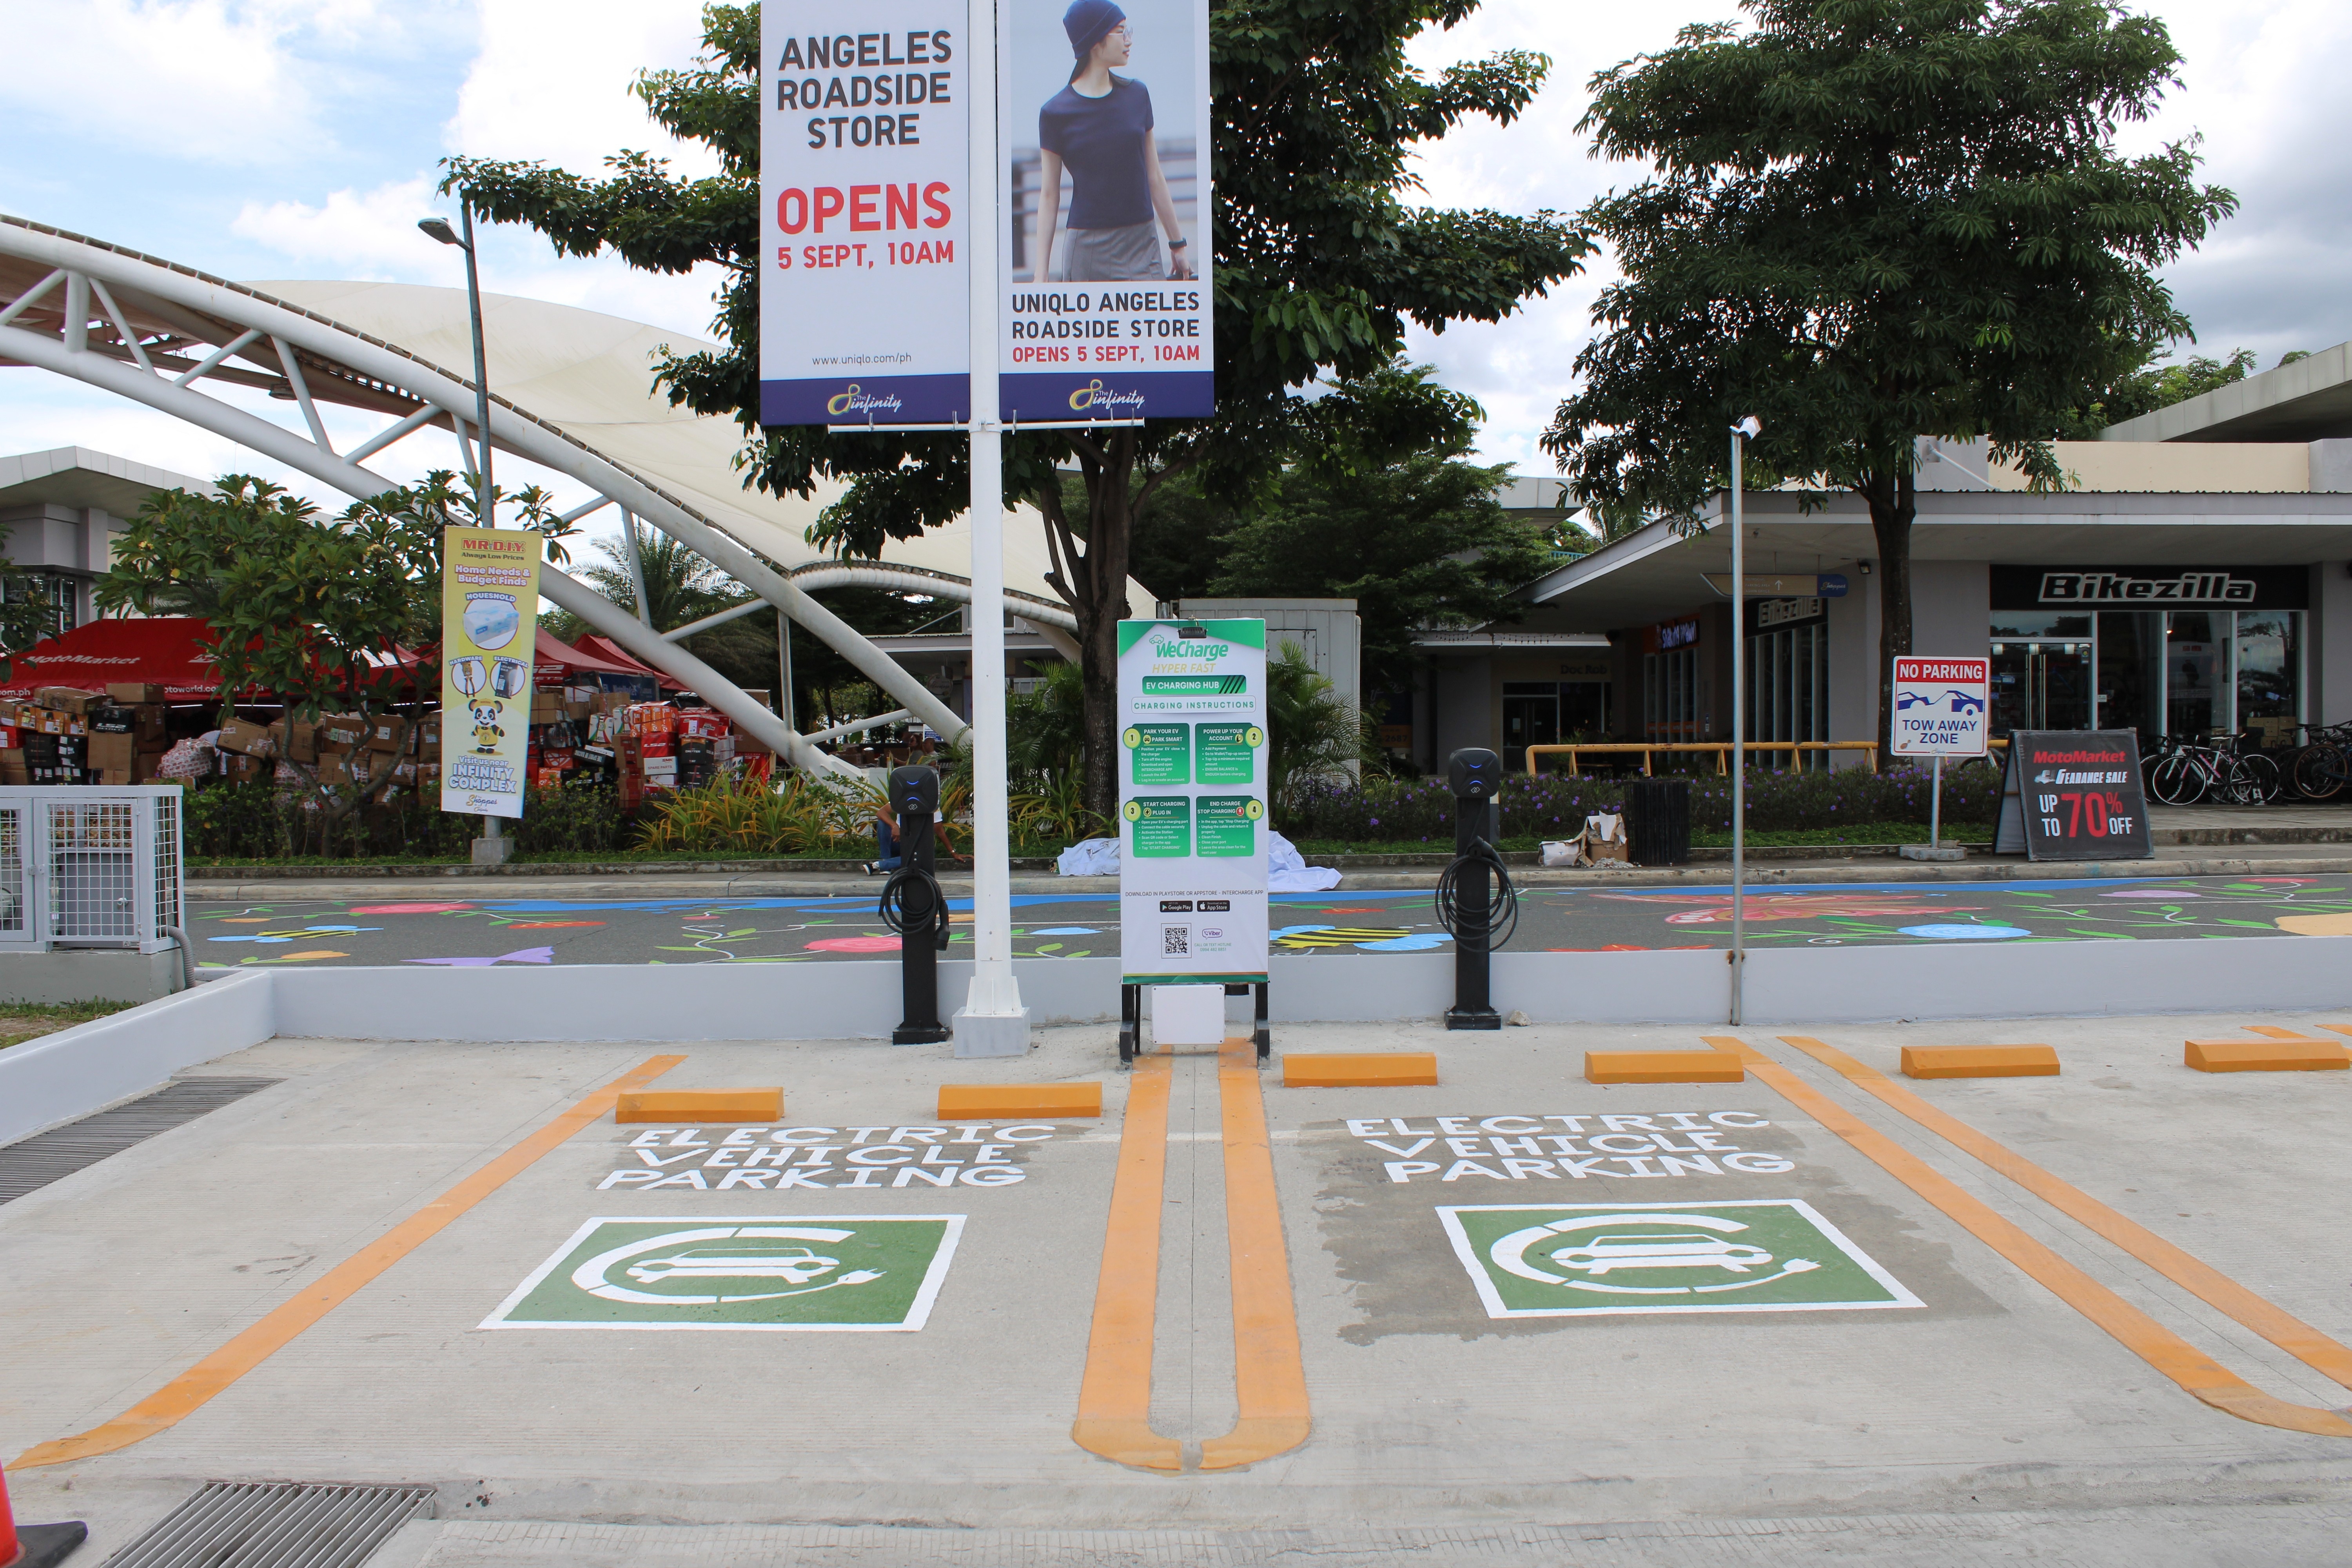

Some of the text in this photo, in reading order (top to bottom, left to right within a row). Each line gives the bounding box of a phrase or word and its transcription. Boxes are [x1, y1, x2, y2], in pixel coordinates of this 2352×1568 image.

[779, 30, 952, 71] ANGELES
[777, 72, 951, 111] ROADSIDE
[807, 113, 920, 149] STORE
[777, 181, 951, 235] OPENS
[778, 240, 953, 270] 5 SEPT, 10AM
[1012, 292, 1199, 316] UNIQLO ANGELES
[1013, 319, 1199, 339] ROADSIDE STORE
[812, 352, 912, 366] www.uniqlo.com/ph
[1013, 345, 1200, 364] OPENS 5 SEPT, 10AM
[851, 394, 902, 414] infinity
[1093, 389, 1145, 410] infinity
[455, 565, 486, 574] Home
[488, 567, 521, 576] Needs
[458, 575, 526, 586] Budget Finds
[1820, 582, 1846, 590] Shoppes
[2038, 572, 2256, 603] Bikezilla
[466, 592, 516, 602] HOUESHOLD
[20, 655, 141, 664] MotoMarket
[1156, 641, 1229, 661] WeCharge
[449, 656, 483, 666] HARDWARE
[494, 656, 528, 668] ELECTRICAL
[1152, 663, 1216, 673] HYPER FAST
[1561, 665, 1607, 674] Doc Rob
[1900, 664, 1982, 679] NO PARKING
[1902, 720, 1977, 731] TOW AWAY
[1919, 733, 1958, 744] ZONE
[459, 756, 477, 764] Visit
[2033, 751, 2126, 764] MotoMarket
[453, 764, 514, 779] INFINITY
[2105, 771, 2127, 783] SALE
[449, 776, 517, 793] COMPLEX
[2039, 794, 2058, 813] UP
[2061, 792, 2123, 838] 70%
[2041, 818, 2061, 837] TO
[2109, 817, 2132, 835] OFF
[1345, 1111, 1770, 1137] ELECTRIC
[627, 1124, 1057, 1147] ELECTRIC
[1363, 1132, 1740, 1159] VEHICLE
[634, 1144, 1017, 1168] VEHICLE
[595, 1165, 1027, 1190] PARKING
[1383, 1152, 1795, 1184] PARKING
